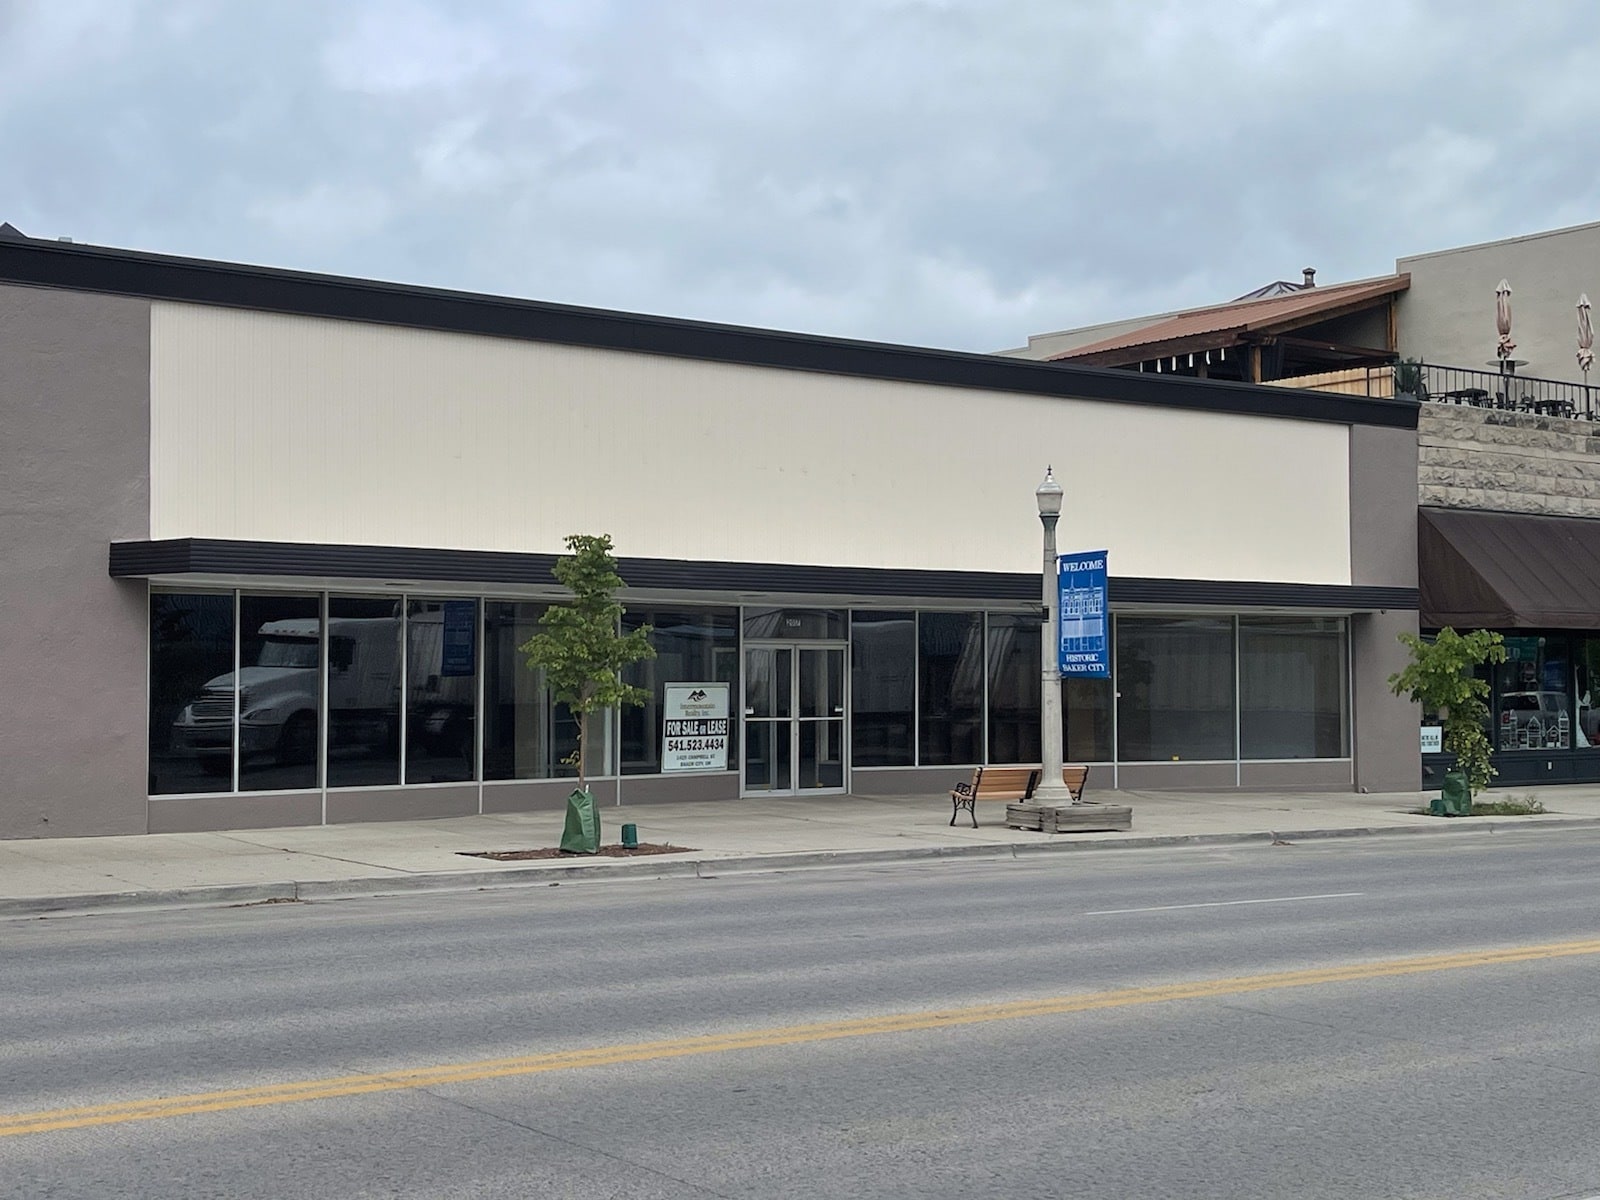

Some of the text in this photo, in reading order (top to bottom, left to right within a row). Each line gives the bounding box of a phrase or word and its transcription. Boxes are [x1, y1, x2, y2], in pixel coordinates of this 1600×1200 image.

[1062, 560, 1104, 572] WELCOME
[1066, 653, 1099, 662] HISTORIC
[1062, 663, 1105, 672] BAKER CITY
[667, 721, 681, 736] FOR
[682, 720, 699, 735] SALE
[707, 720, 727, 735] LEASE
[668, 738, 724, 751] 541.523.4434
